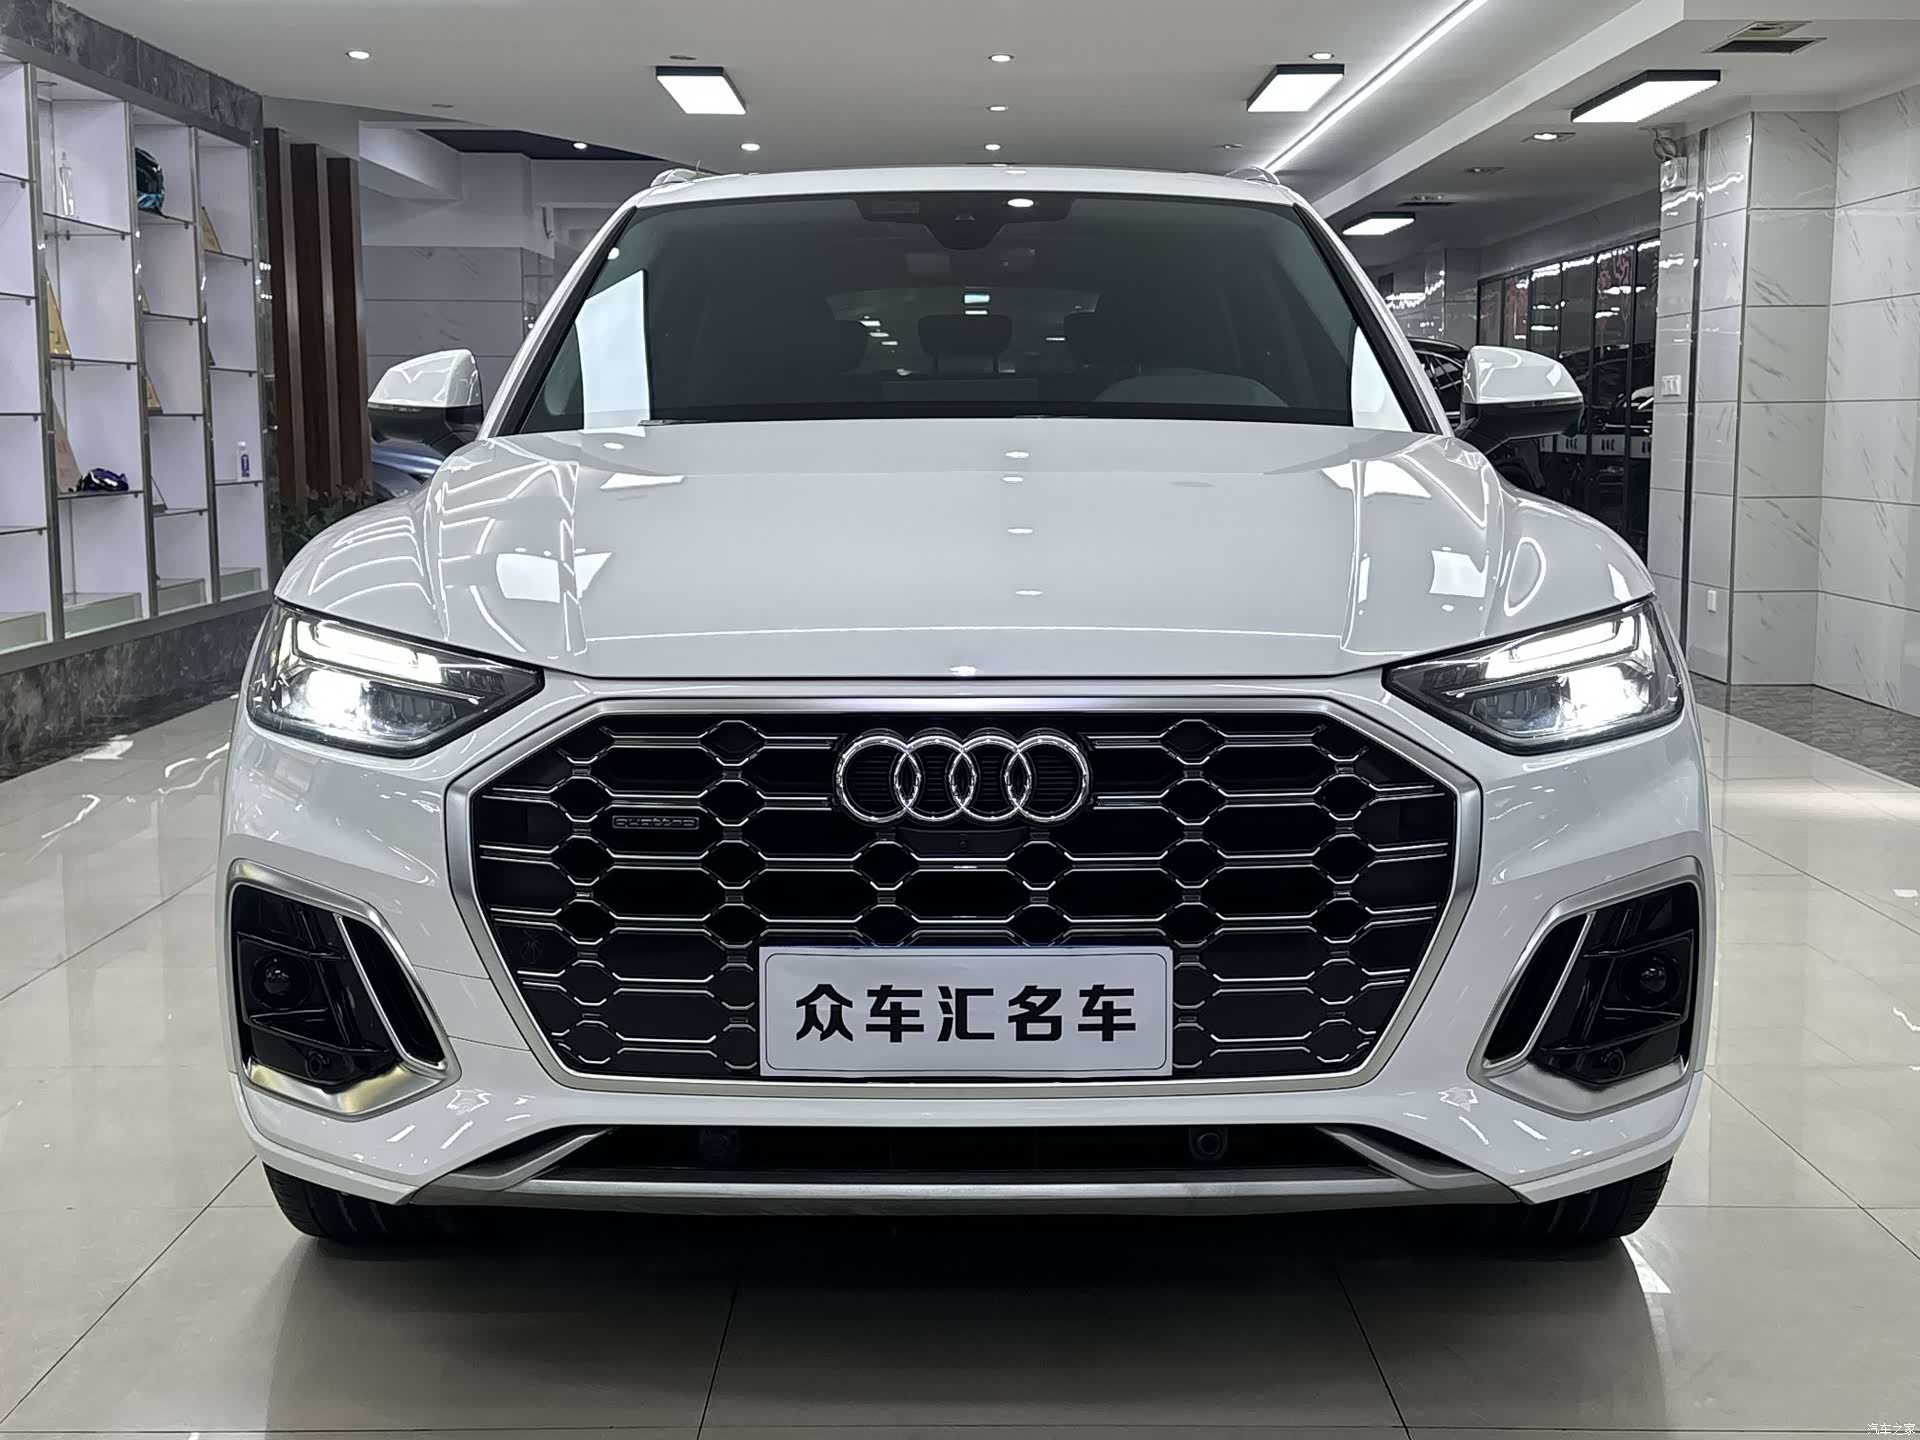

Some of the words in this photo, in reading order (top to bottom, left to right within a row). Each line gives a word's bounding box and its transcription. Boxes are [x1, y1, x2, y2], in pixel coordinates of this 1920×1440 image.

[795, 984, 1137, 1043] 众车汇名车
